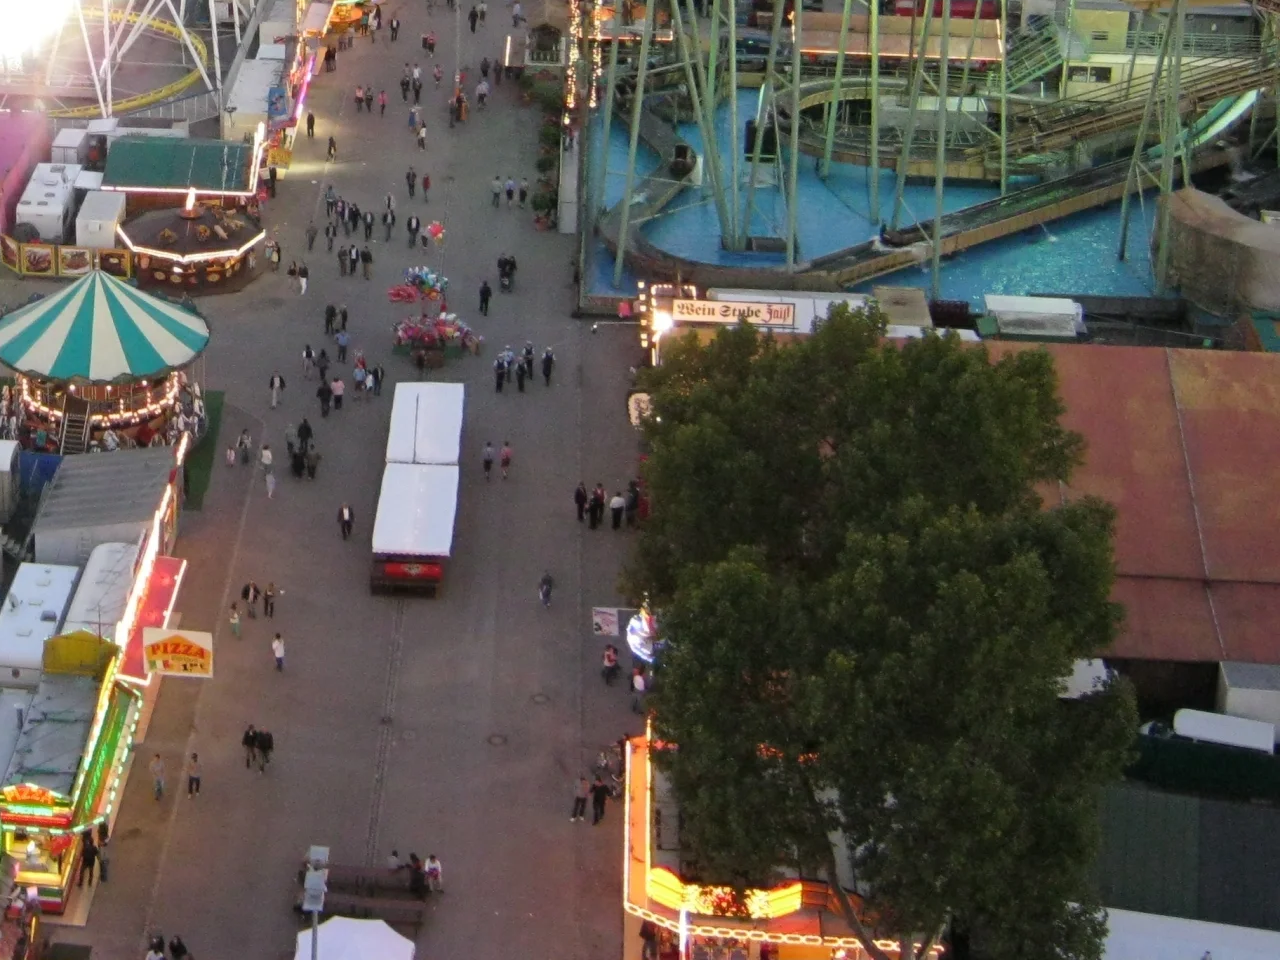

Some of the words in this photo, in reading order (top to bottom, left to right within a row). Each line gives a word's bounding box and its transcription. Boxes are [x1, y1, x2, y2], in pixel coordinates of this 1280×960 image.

[676, 302, 716, 316] Wein
[720, 304, 762, 319] Stube
[151, 642, 205, 660] PIZZA
[3, 785, 56, 805] PIZZA
